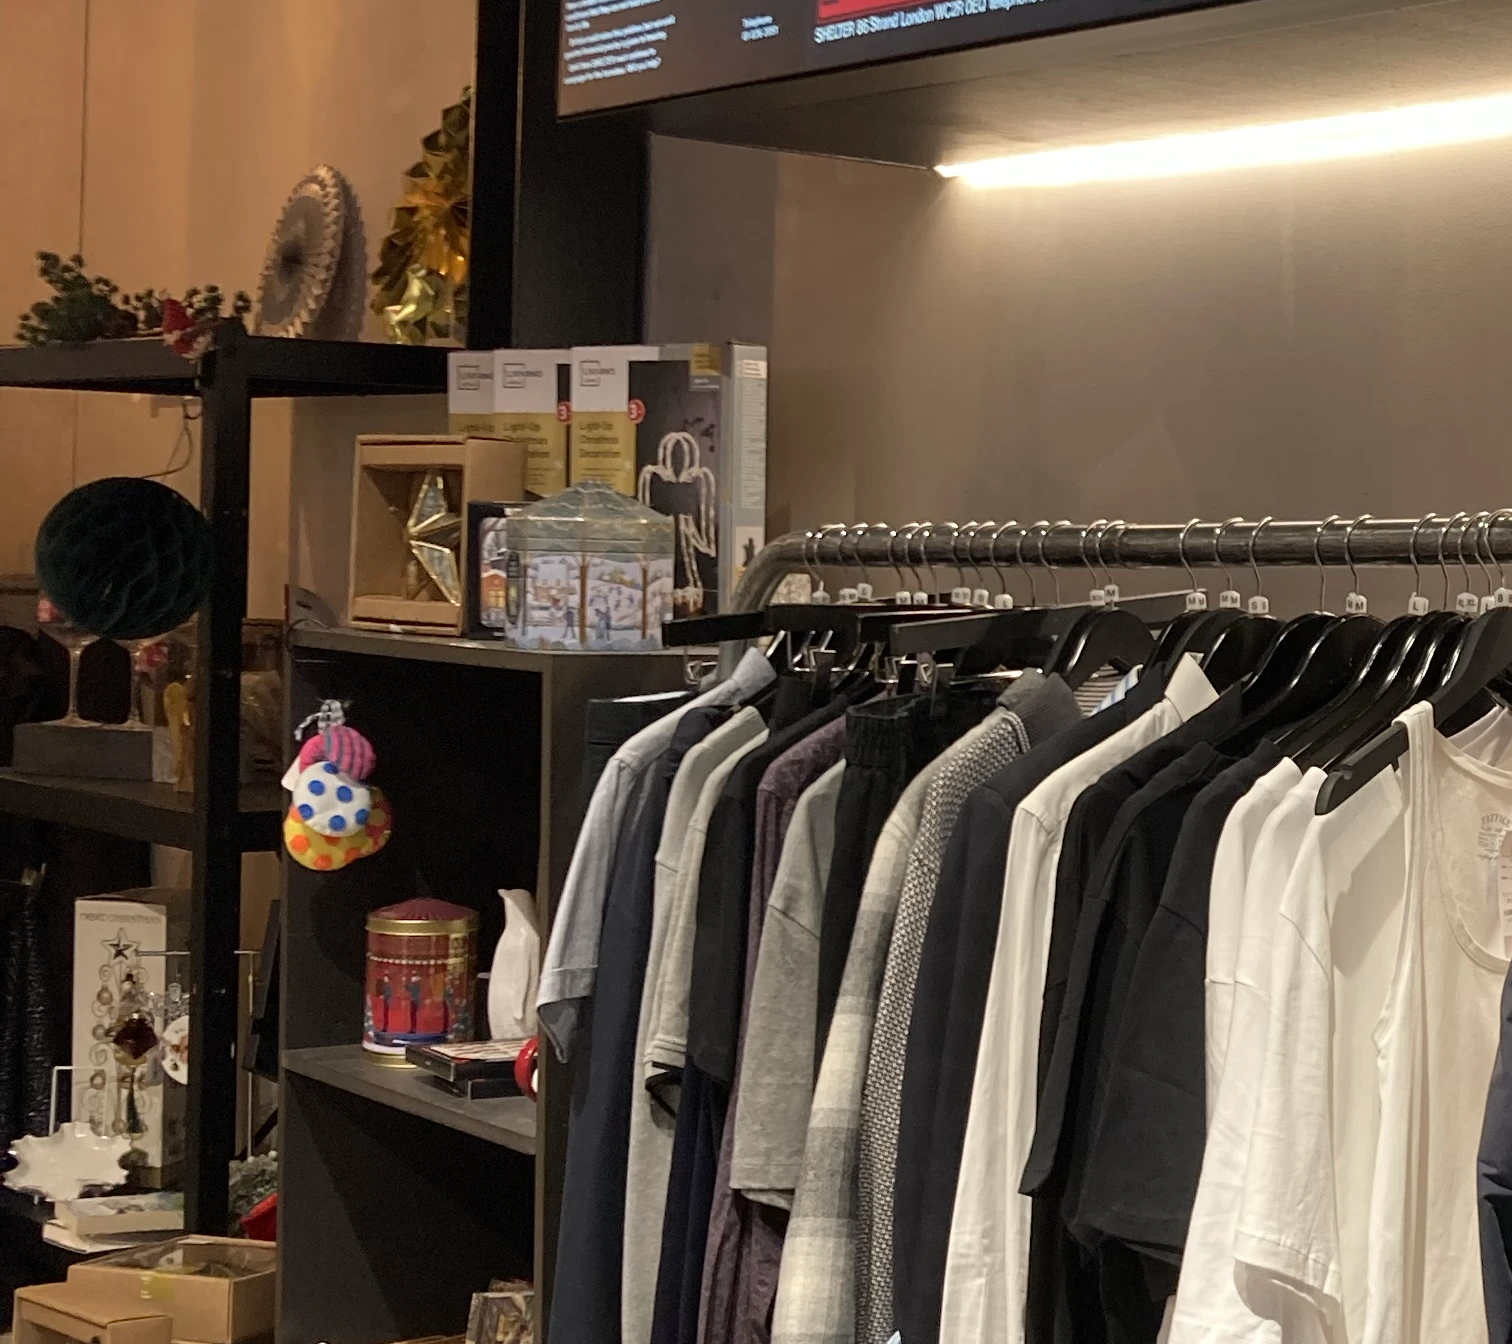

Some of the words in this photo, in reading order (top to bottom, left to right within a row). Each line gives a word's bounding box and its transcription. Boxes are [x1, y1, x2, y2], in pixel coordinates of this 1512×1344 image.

[814, 19, 855, 43] SHELTER
[900, 7, 934, 28] London
[1188, 597, 1196, 605] M
[1355, 601, 1364, 610] M
